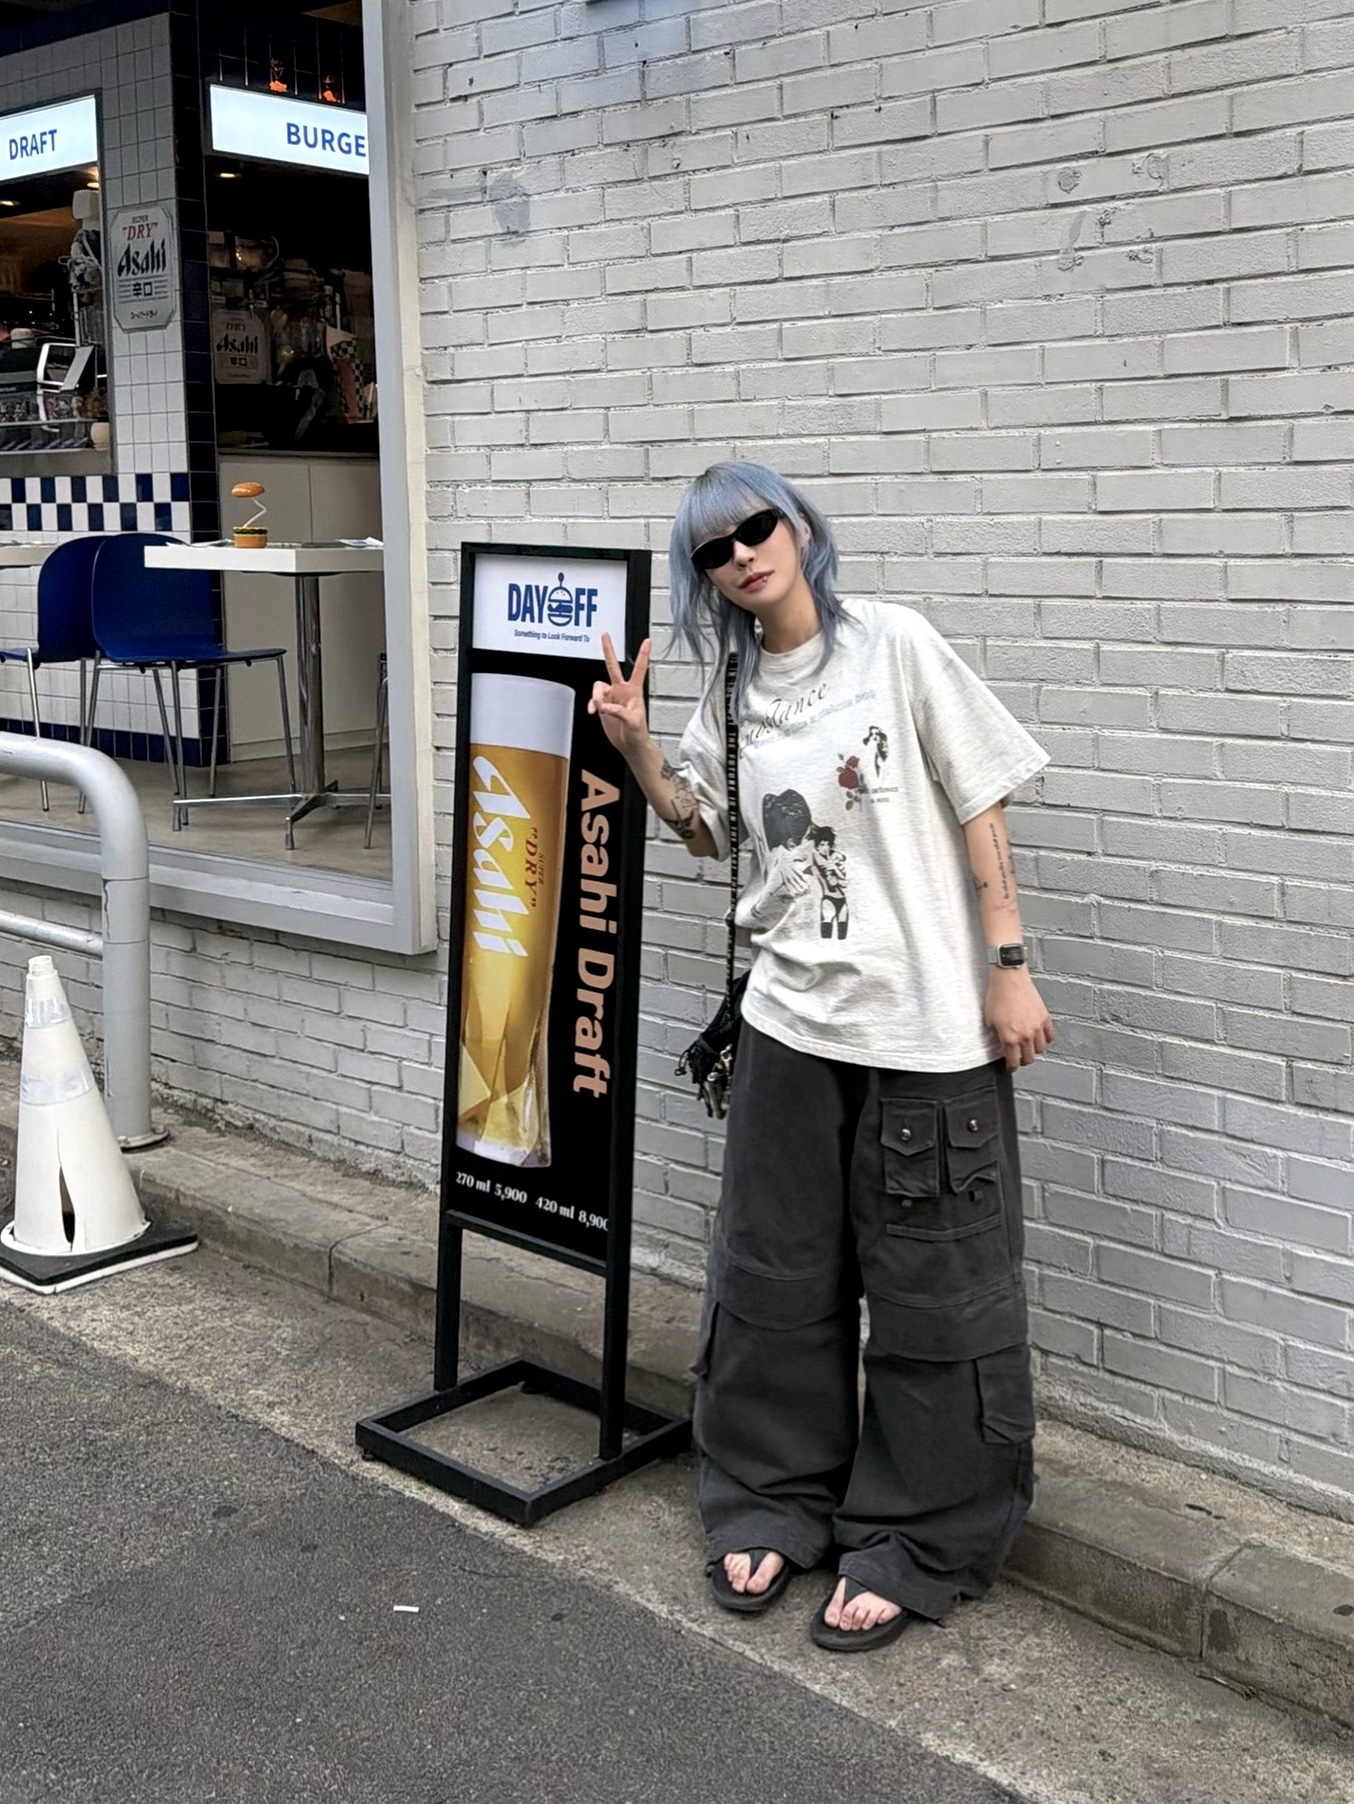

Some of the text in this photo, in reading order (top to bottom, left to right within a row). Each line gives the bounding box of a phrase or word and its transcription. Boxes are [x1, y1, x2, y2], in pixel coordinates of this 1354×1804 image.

[8, 129, 58, 161] DRAFT
[286, 122, 366, 158] BURGE
[117, 237, 167, 277] Asahi
[216, 332, 259, 354] Asahi
[514, 629, 591, 643] Something to Look Forward To
[472, 755, 532, 957] Asahi
[537, 852, 546, 885] SUPER
[572, 769, 621, 1098] Asahi Draft
[455, 1171, 475, 1188] 270
[475, 1179, 490, 1193] ml
[494, 1183, 528, 1204] 5,900
[535, 1196, 558, 1214] 420
[559, 1205, 575, 1220] ml
